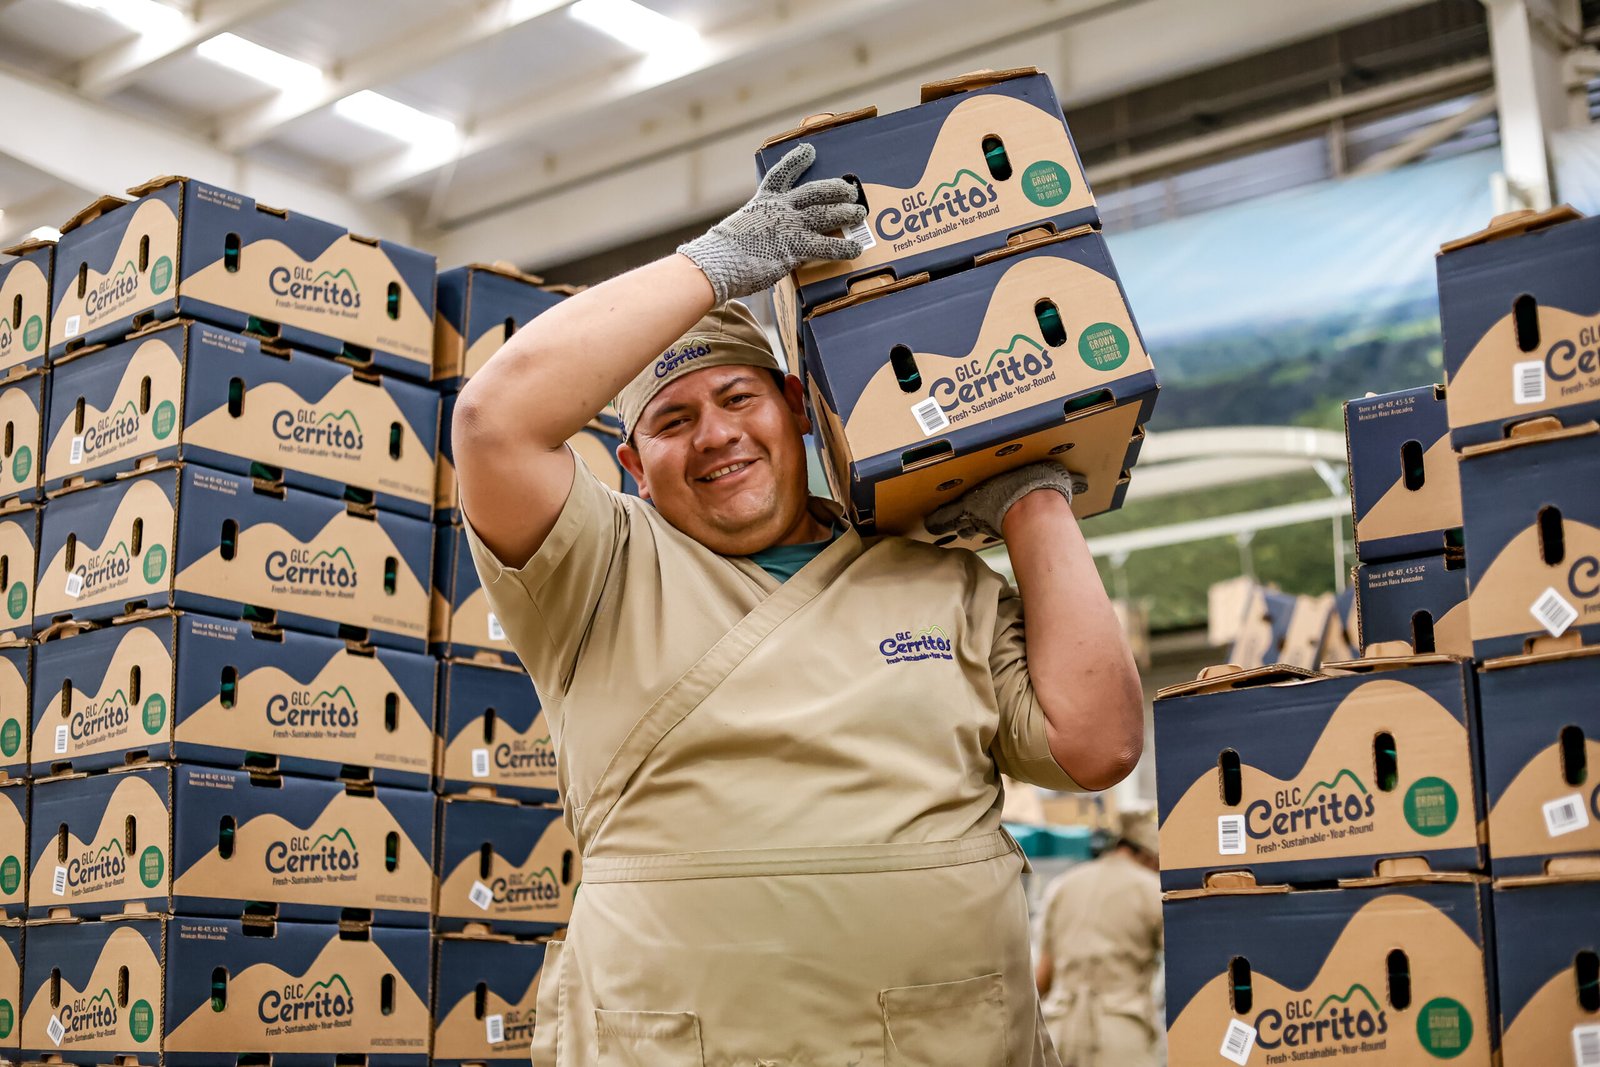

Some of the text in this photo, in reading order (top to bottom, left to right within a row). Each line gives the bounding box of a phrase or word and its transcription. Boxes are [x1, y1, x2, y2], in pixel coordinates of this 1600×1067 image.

[1032, 172, 1058, 187] GROWN
[902, 192, 928, 212] GLC
[1045, 188, 1064, 199] ORDER
[876, 184, 998, 241] Cerritos
[894, 205, 1000, 252] Fresh Sustainable Year-Round
[294, 266, 313, 281] GLC
[86, 275, 138, 316] Cerritos
[270, 266, 360, 308] Cerritos
[1089, 335, 1116, 350] GROWN
[655, 344, 712, 378] Cerritos
[955, 360, 982, 382] GLC
[1095, 357, 1104, 366] TO
[1104, 351, 1123, 362] ORDER
[929, 350, 1053, 412] Cerritos
[948, 372, 1056, 424] Fresh Sustainable Year-Round
[298, 409, 316, 424] GLC
[84, 416, 139, 454] Cerritos
[272, 410, 363, 450] Cerritos
[290, 549, 309, 563] GLC
[266, 551, 357, 587] Cerritos
[1401, 575, 1424, 584] Avocados
[880, 636, 951, 656] Cerritos
[896, 631, 912, 641] GLC
[86, 703, 98, 718] GLC
[266, 694, 358, 727] Cerritos
[292, 692, 310, 705] GLC
[71, 707, 129, 740] Cerritos
[495, 743, 558, 769] Cerrito
[1276, 787, 1302, 809] GLC
[1245, 793, 1375, 839] Cerritos
[291, 836, 309, 851] GLC
[1257, 822, 1374, 854] Fresh Sustainable Year-Round
[82, 851, 94, 866] GLC
[266, 841, 359, 873] Cerritos
[67, 856, 126, 887] Cerritos
[492, 877, 560, 904] Cerritos
[284, 984, 304, 1000] GLC
[74, 998, 86, 1013] GLC
[258, 990, 354, 1024] Cerritos
[1286, 999, 1313, 1020] GLC
[60, 1005, 118, 1034] Cerritos
[1254, 1008, 1388, 1050] Cerritos
[1266, 1040, 1387, 1065] Fresh Sustainable Year-Round
